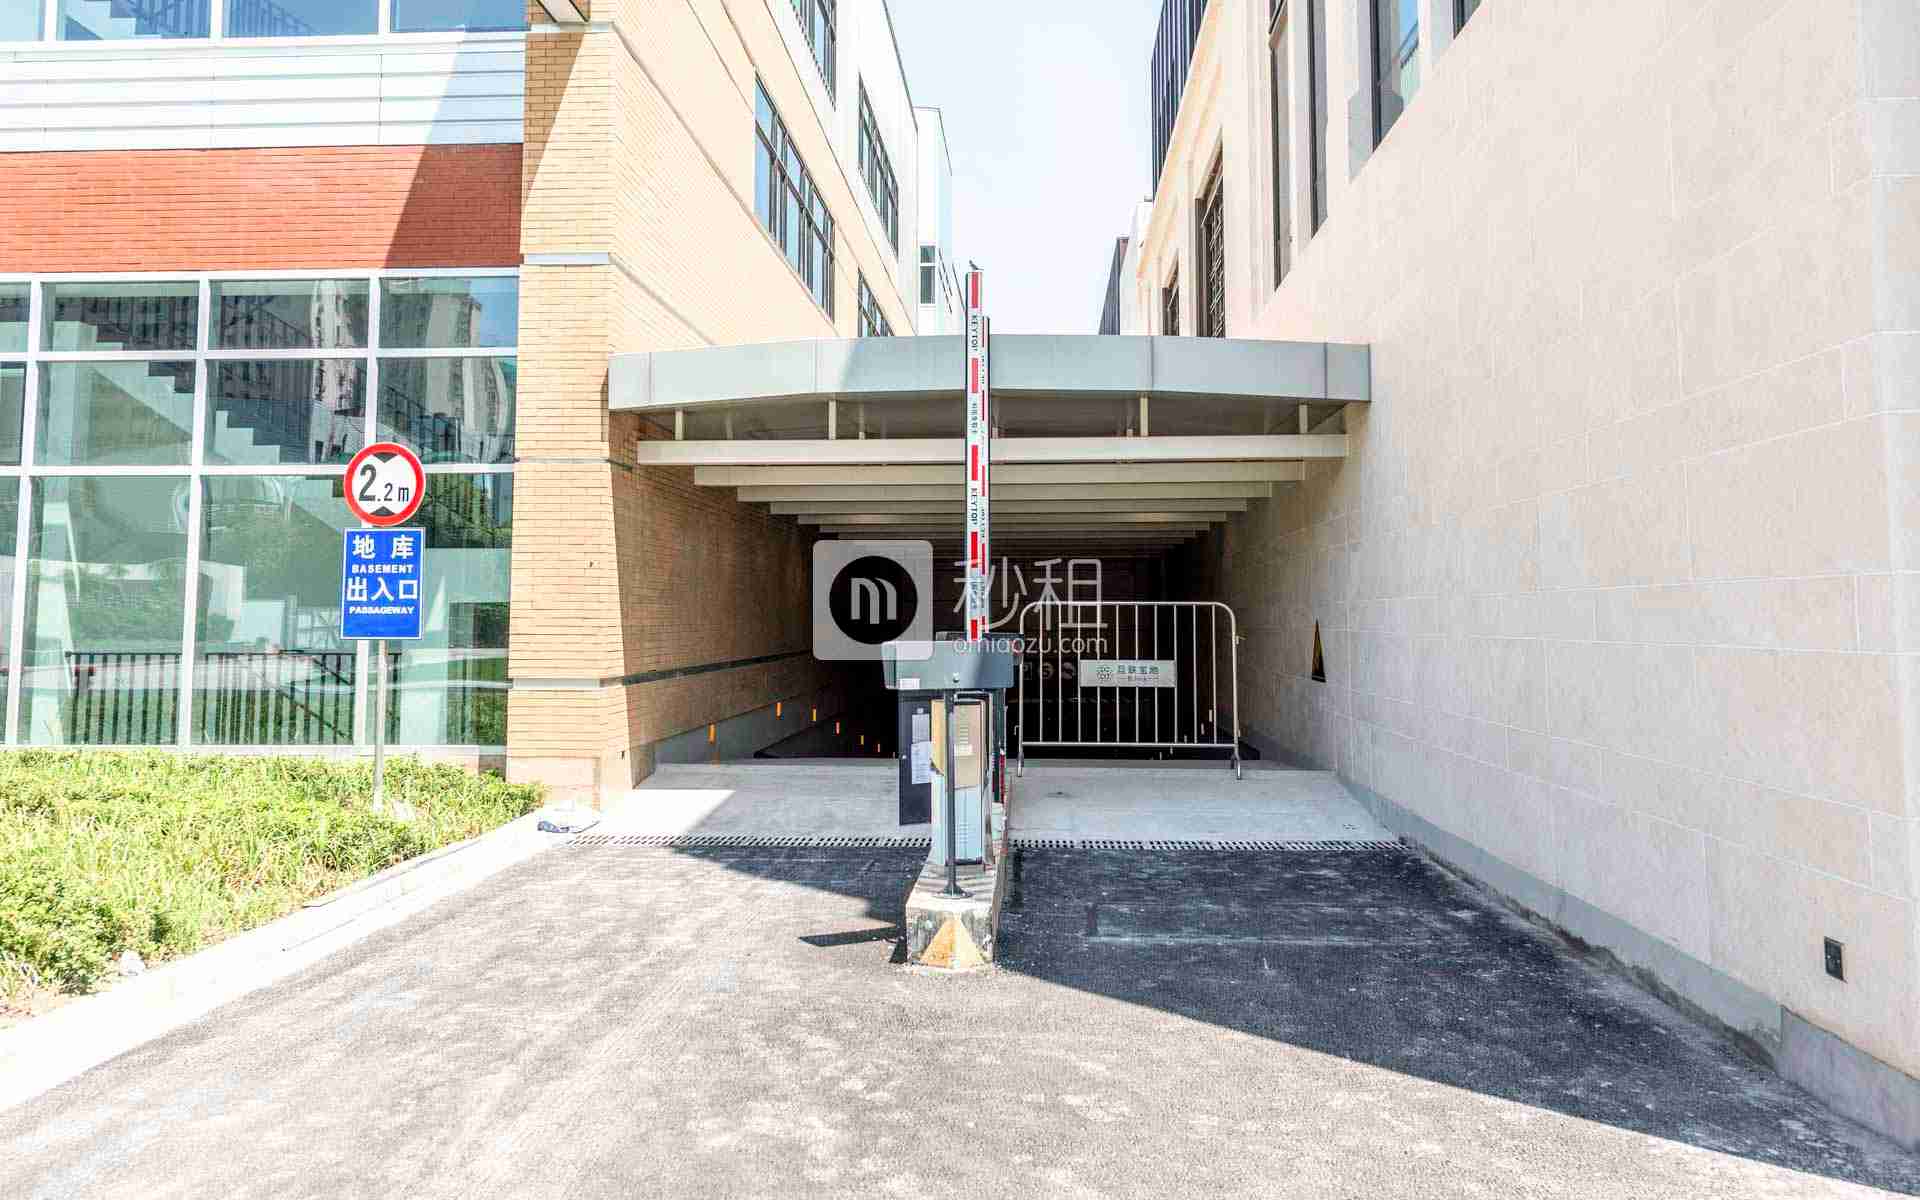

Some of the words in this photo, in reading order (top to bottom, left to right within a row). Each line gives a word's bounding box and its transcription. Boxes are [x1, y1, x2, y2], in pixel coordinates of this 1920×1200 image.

[352, 535, 414, 559] 地库
[351, 564, 413, 574] BASEMENT
[346, 577, 418, 602] 出入口
[349, 606, 415, 614] PASSAGEWAY
